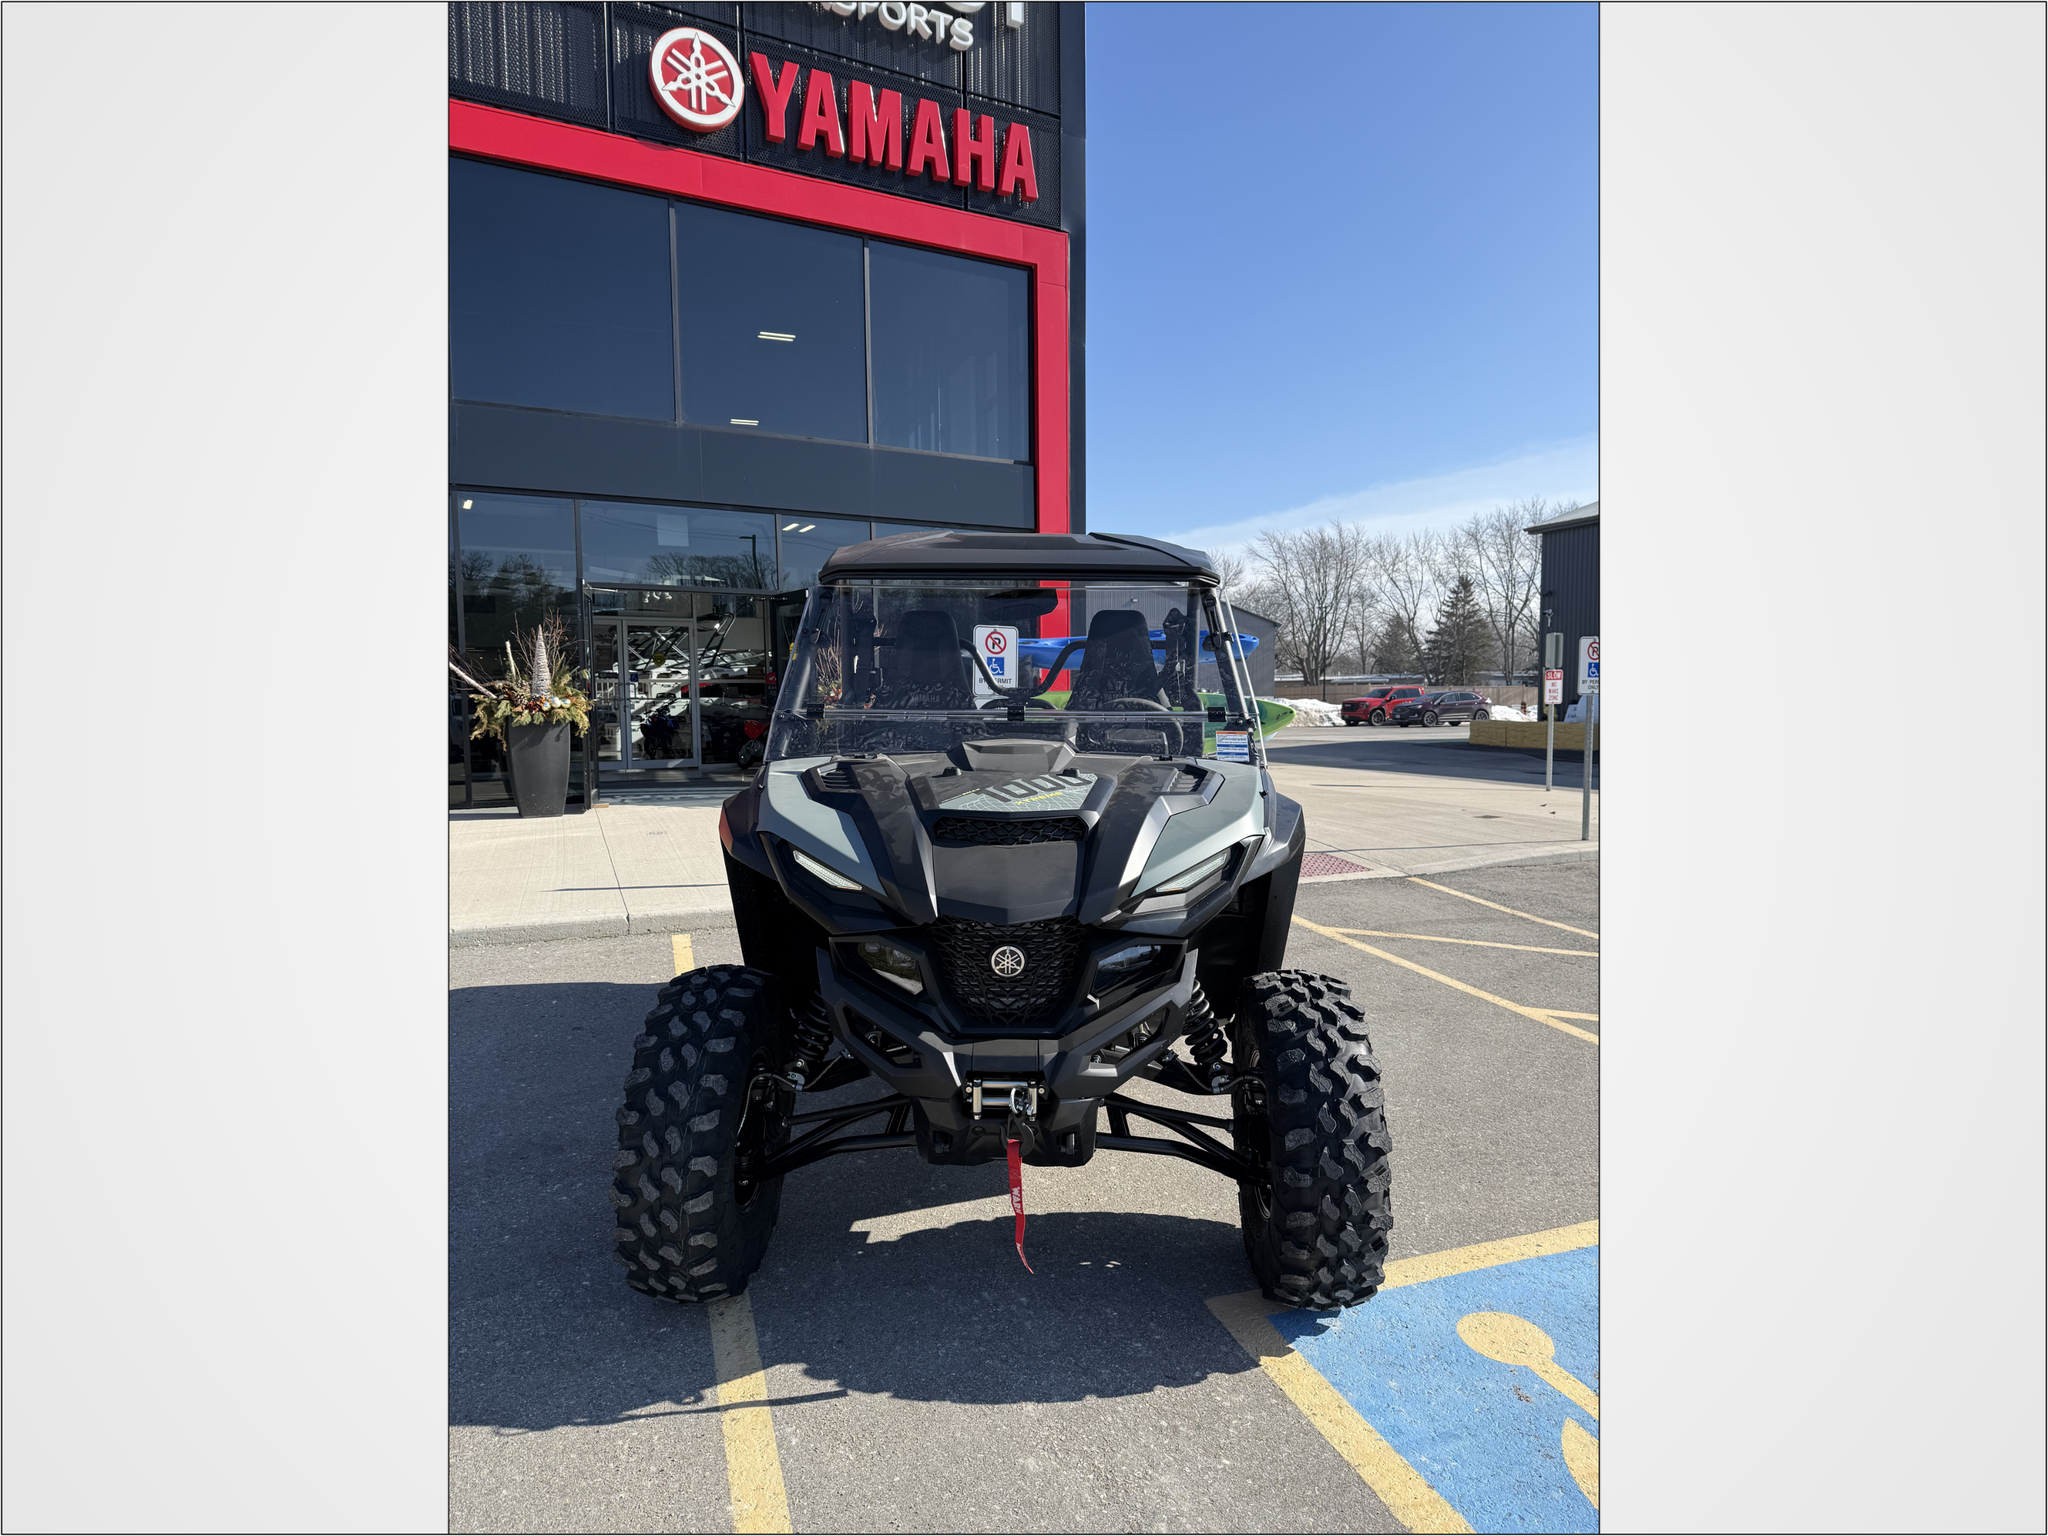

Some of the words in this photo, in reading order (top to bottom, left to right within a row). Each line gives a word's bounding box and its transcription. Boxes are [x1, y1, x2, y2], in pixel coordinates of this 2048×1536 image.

[821, 2, 973, 50] PORTS
[750, 51, 1038, 203] YAMAHA
[1012, 1187, 1022, 1215] WARN
